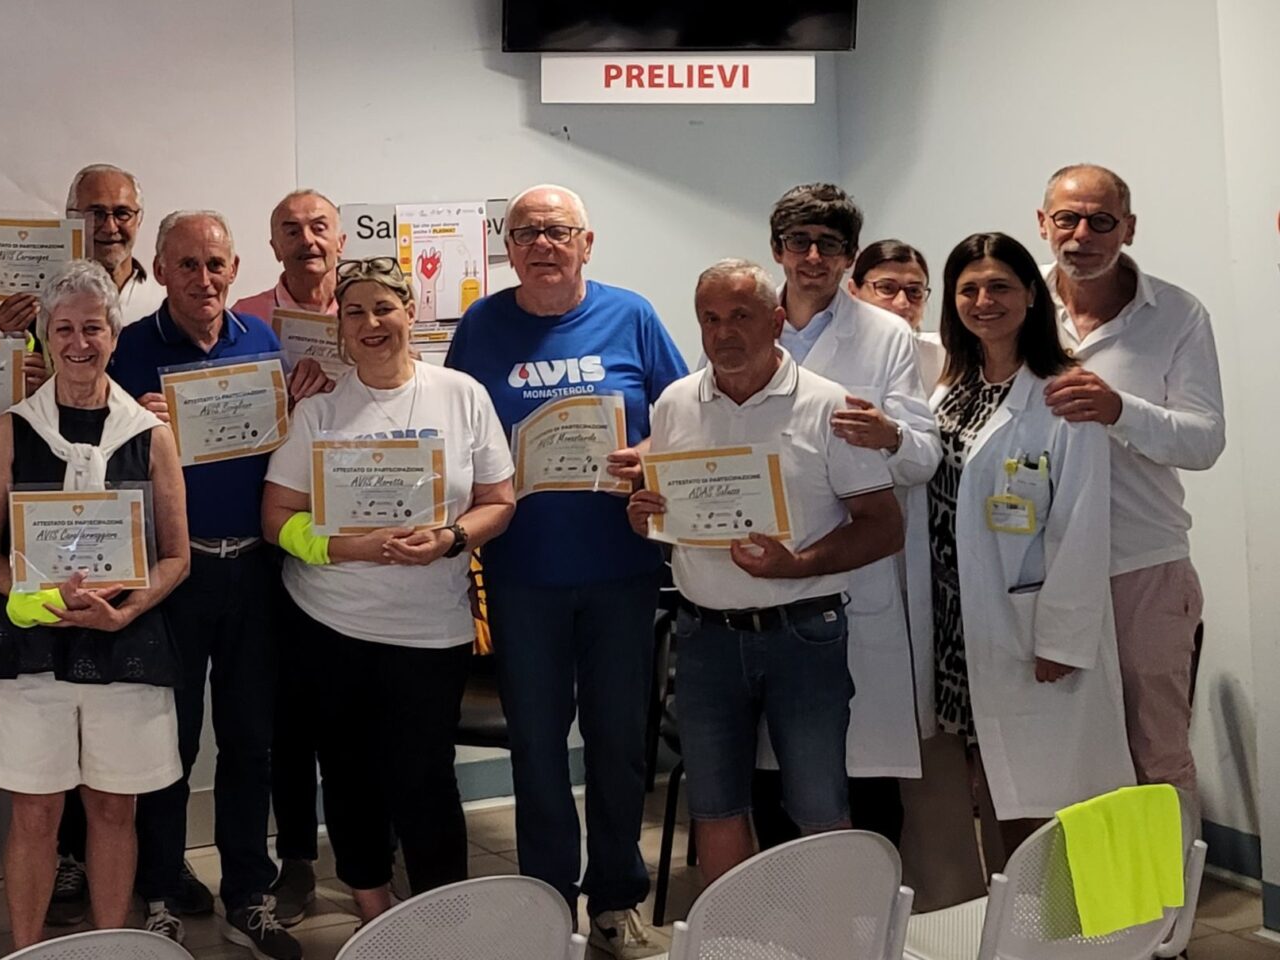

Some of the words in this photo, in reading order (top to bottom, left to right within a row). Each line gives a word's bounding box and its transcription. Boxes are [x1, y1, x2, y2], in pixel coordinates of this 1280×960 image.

[603, 63, 750, 89] PRELIEVI
[507, 355, 606, 388] AVIS
[523, 384, 595, 399] MONASTEROLO
